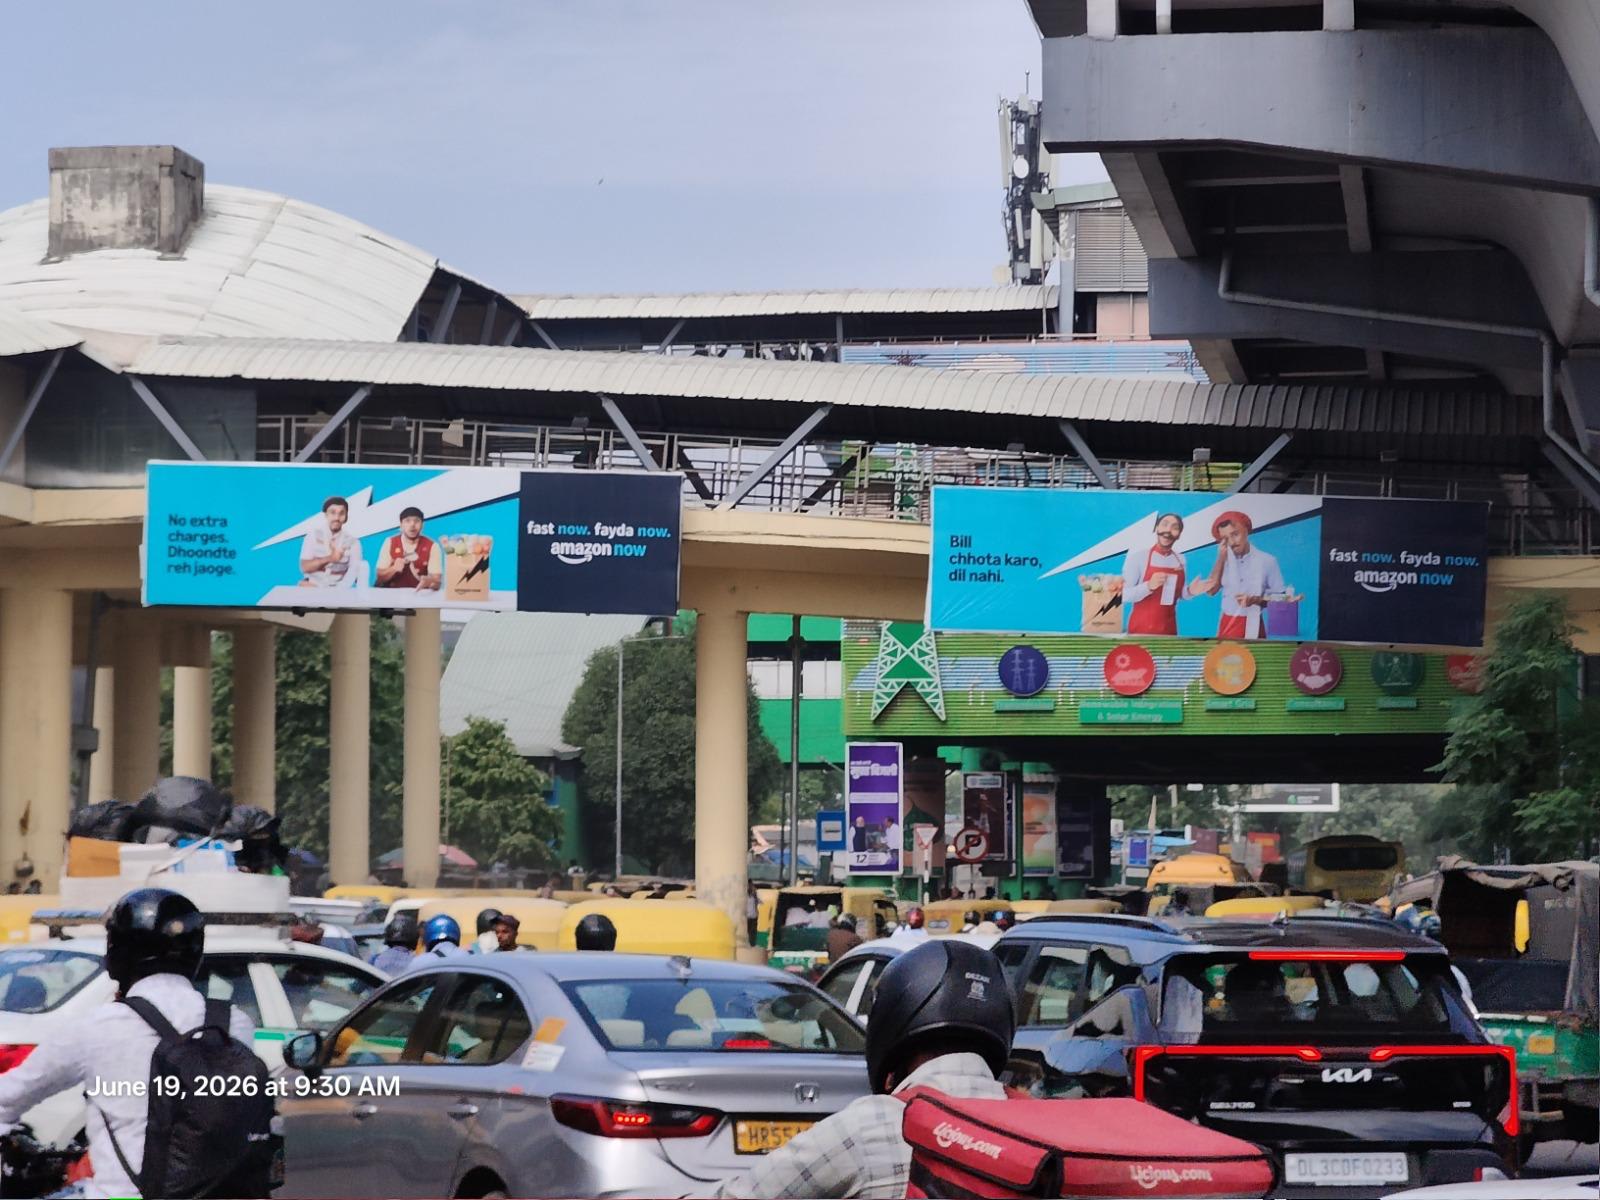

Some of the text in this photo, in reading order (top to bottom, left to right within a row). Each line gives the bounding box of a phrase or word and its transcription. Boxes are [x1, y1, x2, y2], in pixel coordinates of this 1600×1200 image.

[168, 513, 228, 528] No extra
[168, 530, 229, 545] charges.
[526, 520, 671, 539] fast now. fayda now.
[950, 534, 972, 548] Bill
[168, 545, 236, 559] Dhoondte
[550, 541, 647, 562] amazon now
[1329, 548, 1479, 567] fast now. fayda now.
[167, 560, 236, 576] reh jaoge.
[949, 552, 1042, 568] chhota karo,
[949, 568, 1004, 582] dil nahi.
[1354, 570, 1454, 591] amazon now
[965, 833, 982, 855] P
